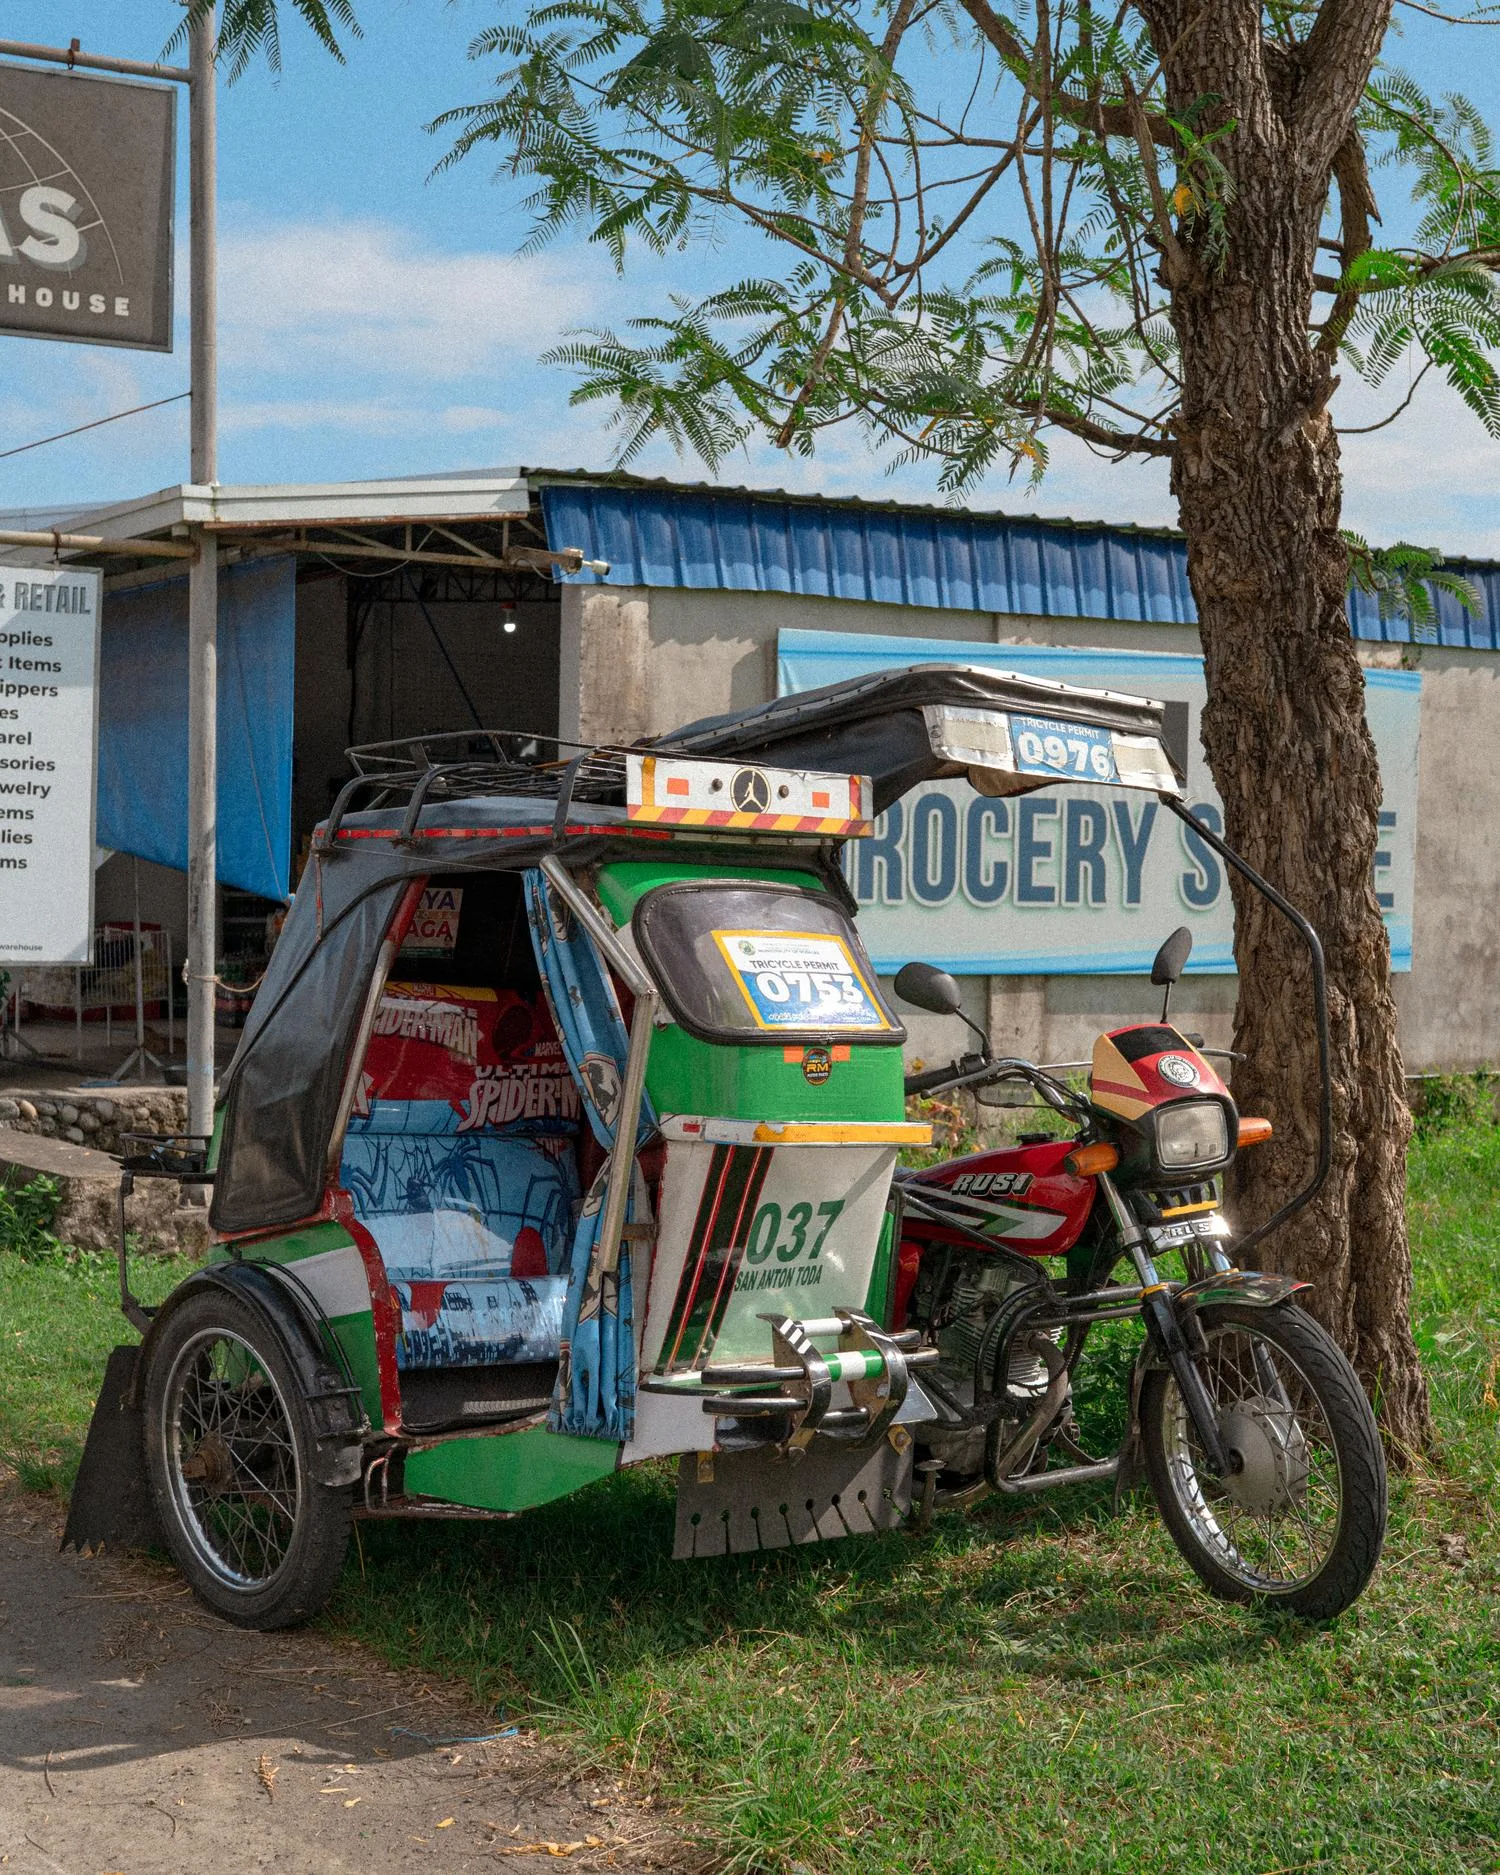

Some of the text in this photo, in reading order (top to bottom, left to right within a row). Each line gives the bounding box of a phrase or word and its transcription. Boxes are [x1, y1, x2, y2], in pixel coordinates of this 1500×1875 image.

[0, 186, 81, 265] S
[8, 284, 129, 316] HOUSE
[15, 582, 91, 615] RETAIL
[9, 656, 62, 673] Items
[1020, 717, 1100, 739] TRICYCLE PERMIT
[1018, 732, 1110, 778] 0976
[1, 830, 33, 845] lies
[841, 793, 1158, 905] ROCERY
[416, 891, 455, 910] YA
[750, 960, 840, 971] TRICYCLE PERMIT
[756, 971, 864, 1004] 0753
[374, 1007, 478, 1058] IDER-MAN
[535, 1041, 562, 1056] MARVE
[806, 1063, 829, 1072] RM
[456, 1076, 580, 1133] SPIDER-M
[951, 1173, 1034, 1197] RUSI
[746, 1199, 846, 1265] 037
[734, 1264, 823, 1292] SAN ANTON TODA
